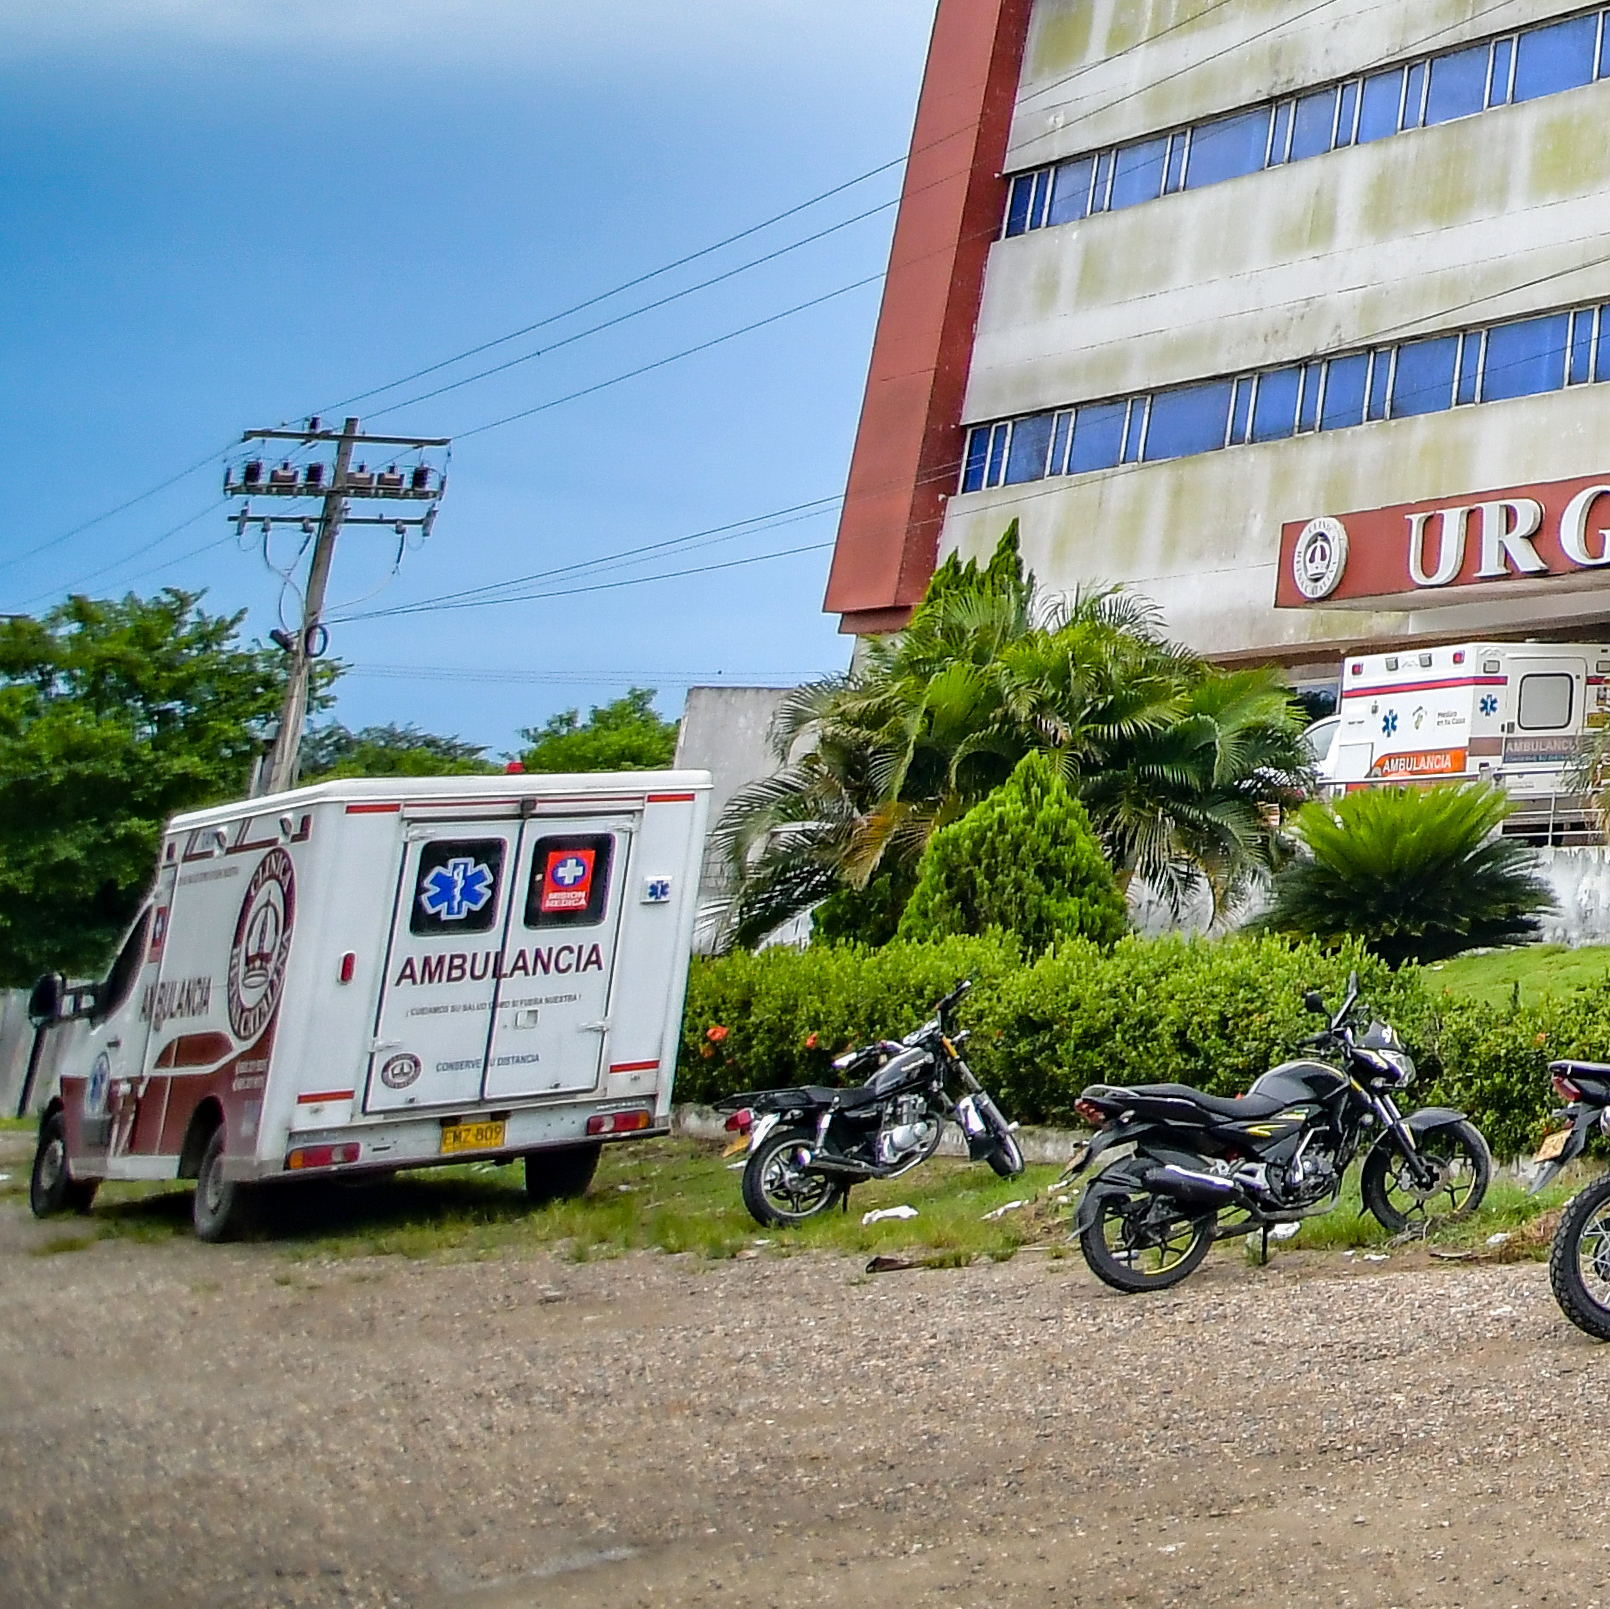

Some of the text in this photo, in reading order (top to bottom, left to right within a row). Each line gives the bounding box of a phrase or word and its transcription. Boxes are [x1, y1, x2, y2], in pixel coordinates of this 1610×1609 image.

[1383, 754, 1452, 773] AMBULANCIA
[545, 898, 587, 907] MEDICA
[548, 891, 587, 900] MISION
[395, 942, 604, 987] AMBULANCIA
